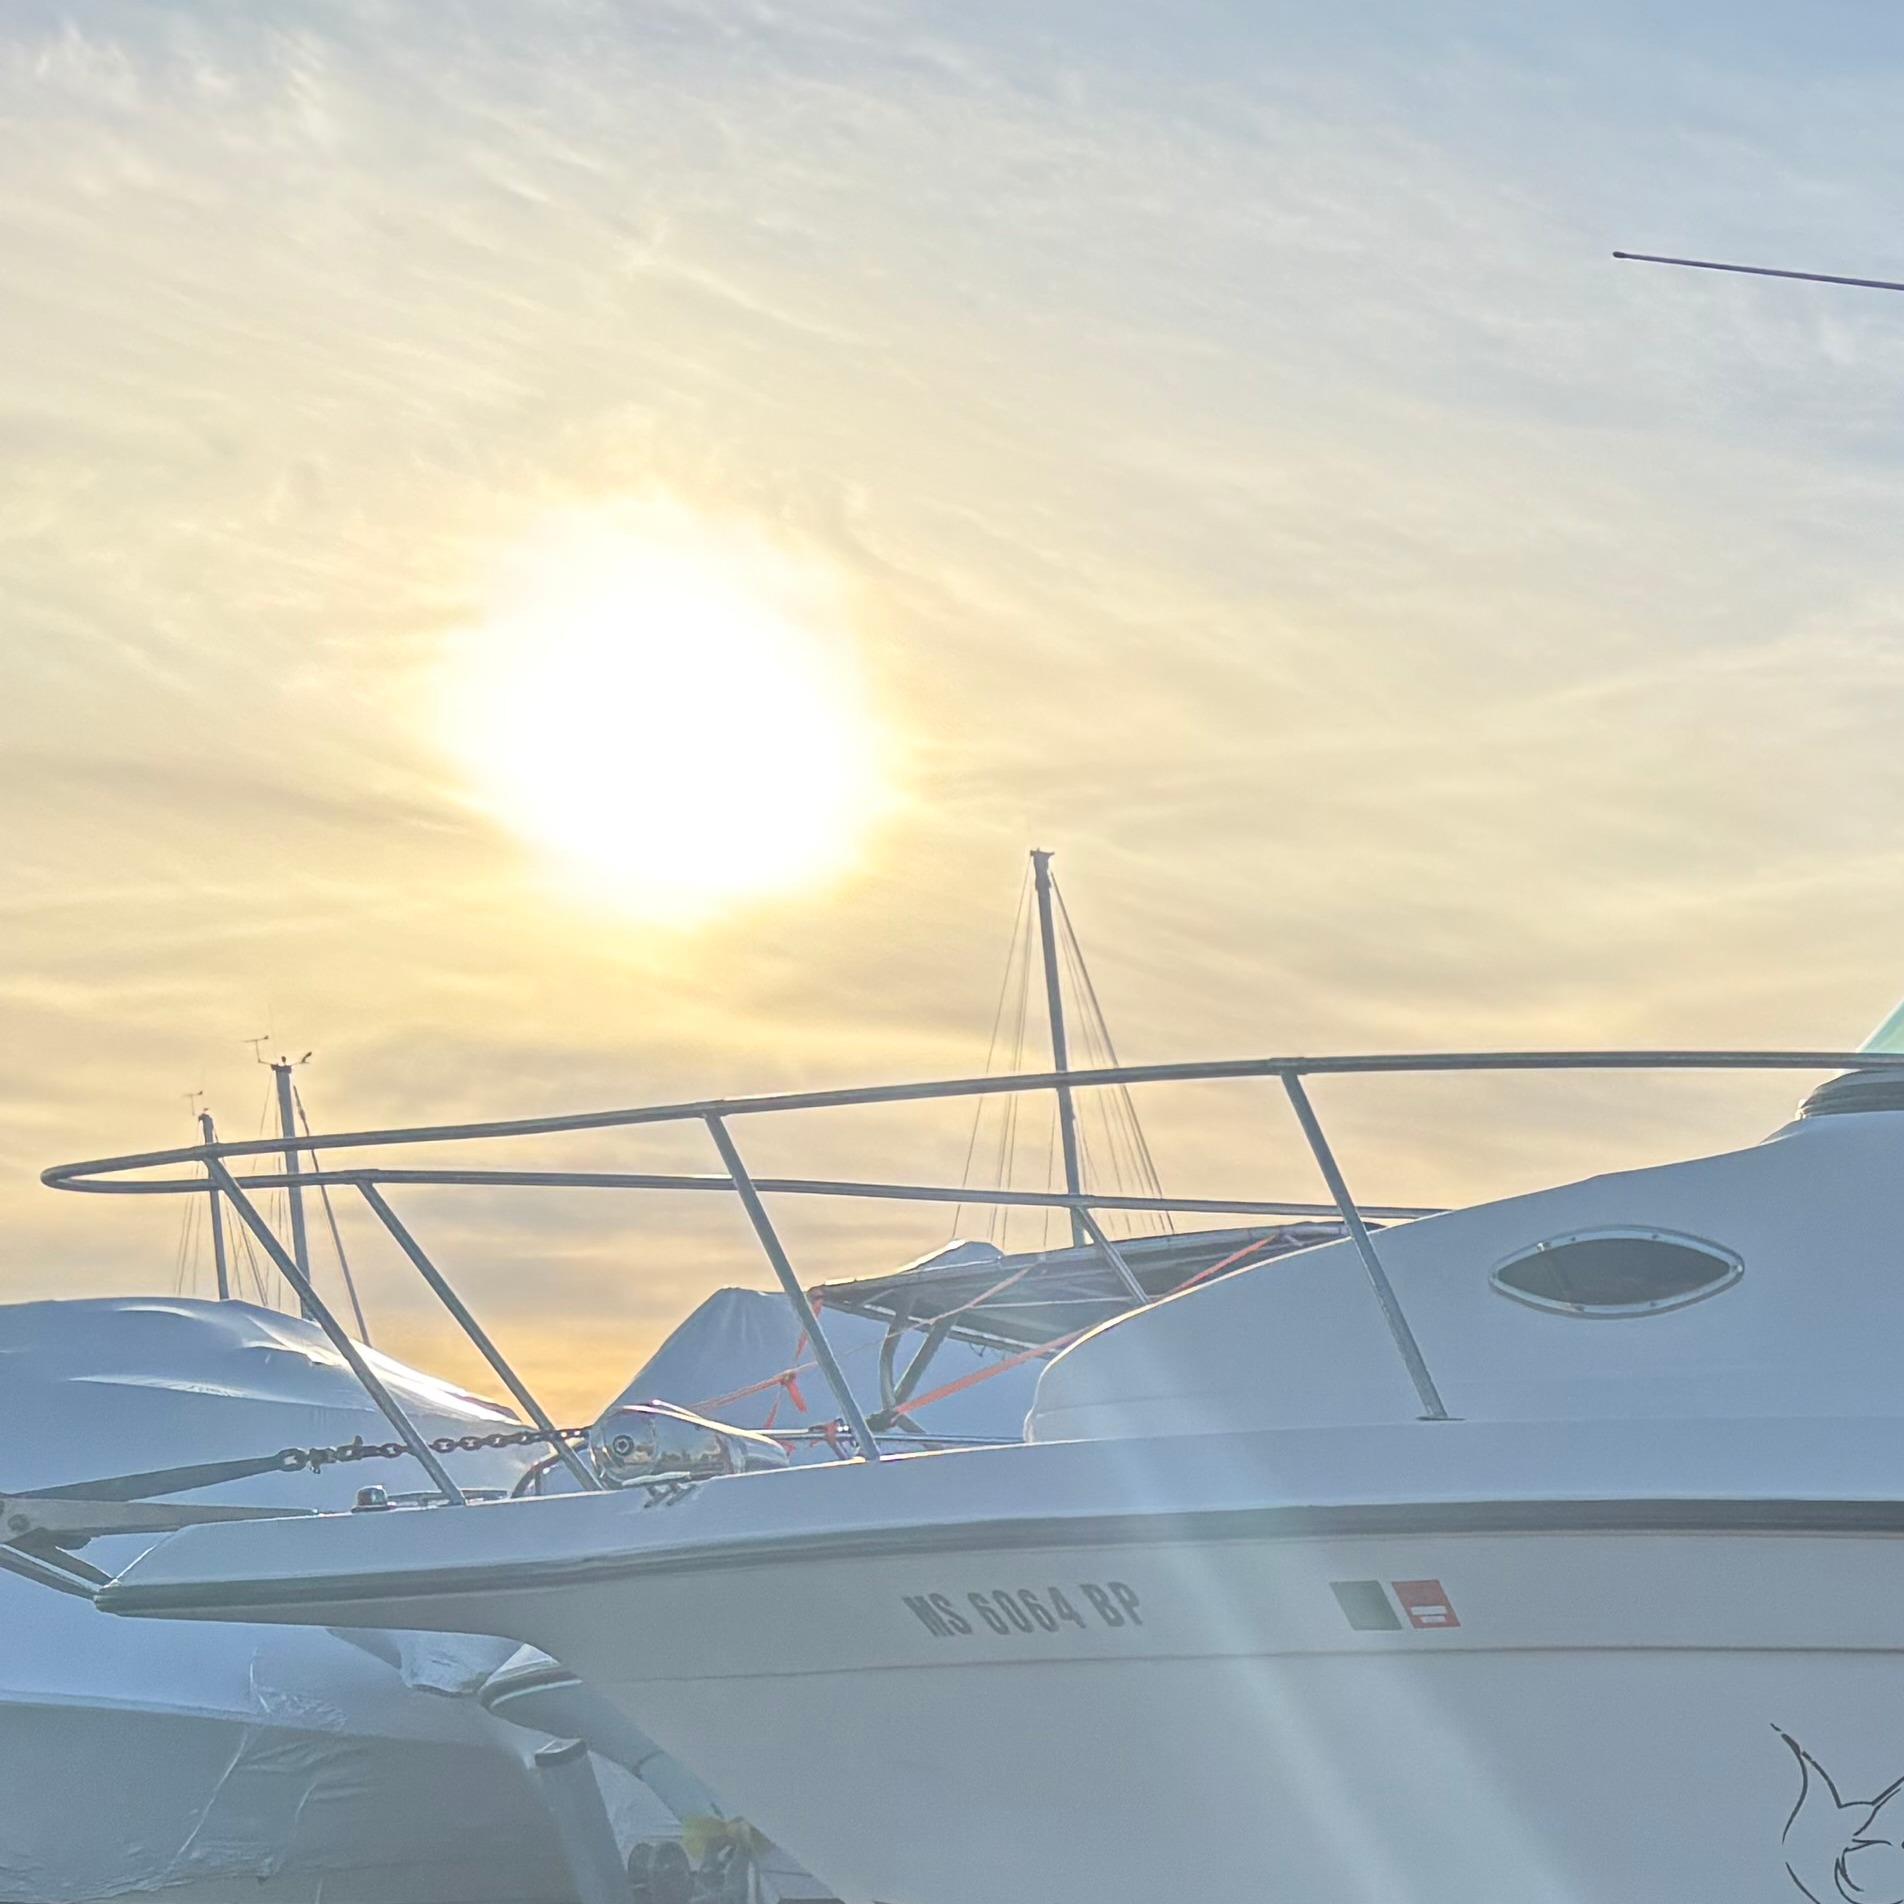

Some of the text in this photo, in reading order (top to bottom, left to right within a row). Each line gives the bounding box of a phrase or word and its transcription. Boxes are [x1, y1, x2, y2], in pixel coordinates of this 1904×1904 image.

[901, 1581, 1143, 1637] MS 6064 BP
